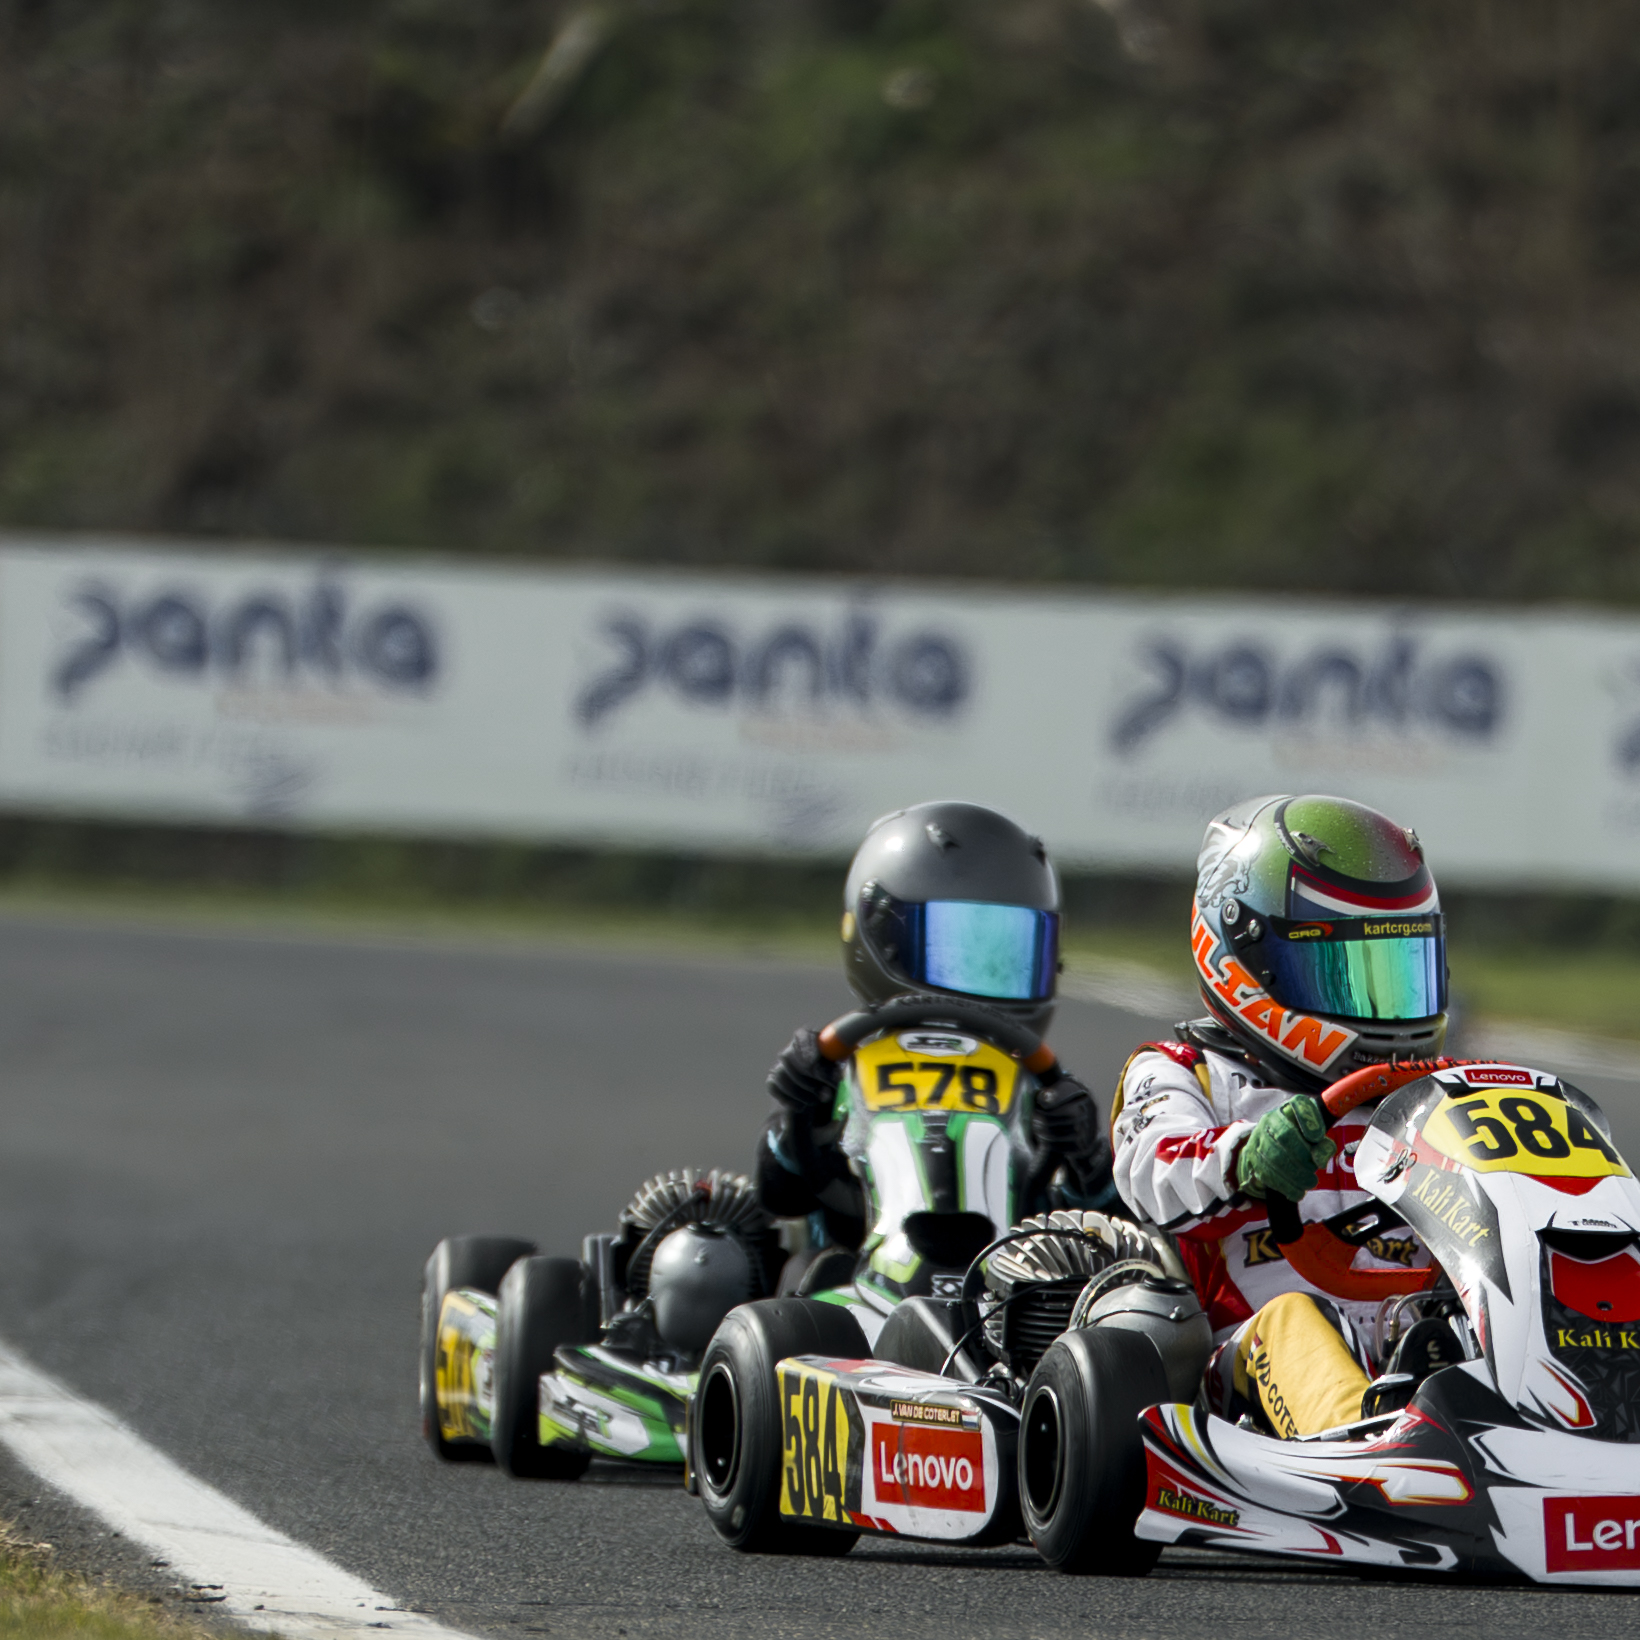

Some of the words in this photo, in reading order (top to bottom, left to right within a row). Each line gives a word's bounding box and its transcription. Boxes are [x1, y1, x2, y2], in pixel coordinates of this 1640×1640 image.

[1363, 922, 1433, 937] kartcrg.com
[877, 1062, 1000, 1114] 578
[1471, 1071, 1526, 1082] Lenovo
[1446, 1097, 1622, 1166] 584
[1412, 1169, 1455, 1216] Kali
[1441, 1196, 1490, 1247] Kart
[1556, 1328, 1612, 1348] Kali
[1267, 1383, 1299, 1438] COTE
[784, 1370, 844, 1524] 584
[880, 1441, 974, 1491] Lenovo
[1158, 1490, 1192, 1514] Kali
[1197, 1501, 1238, 1525] Kart
